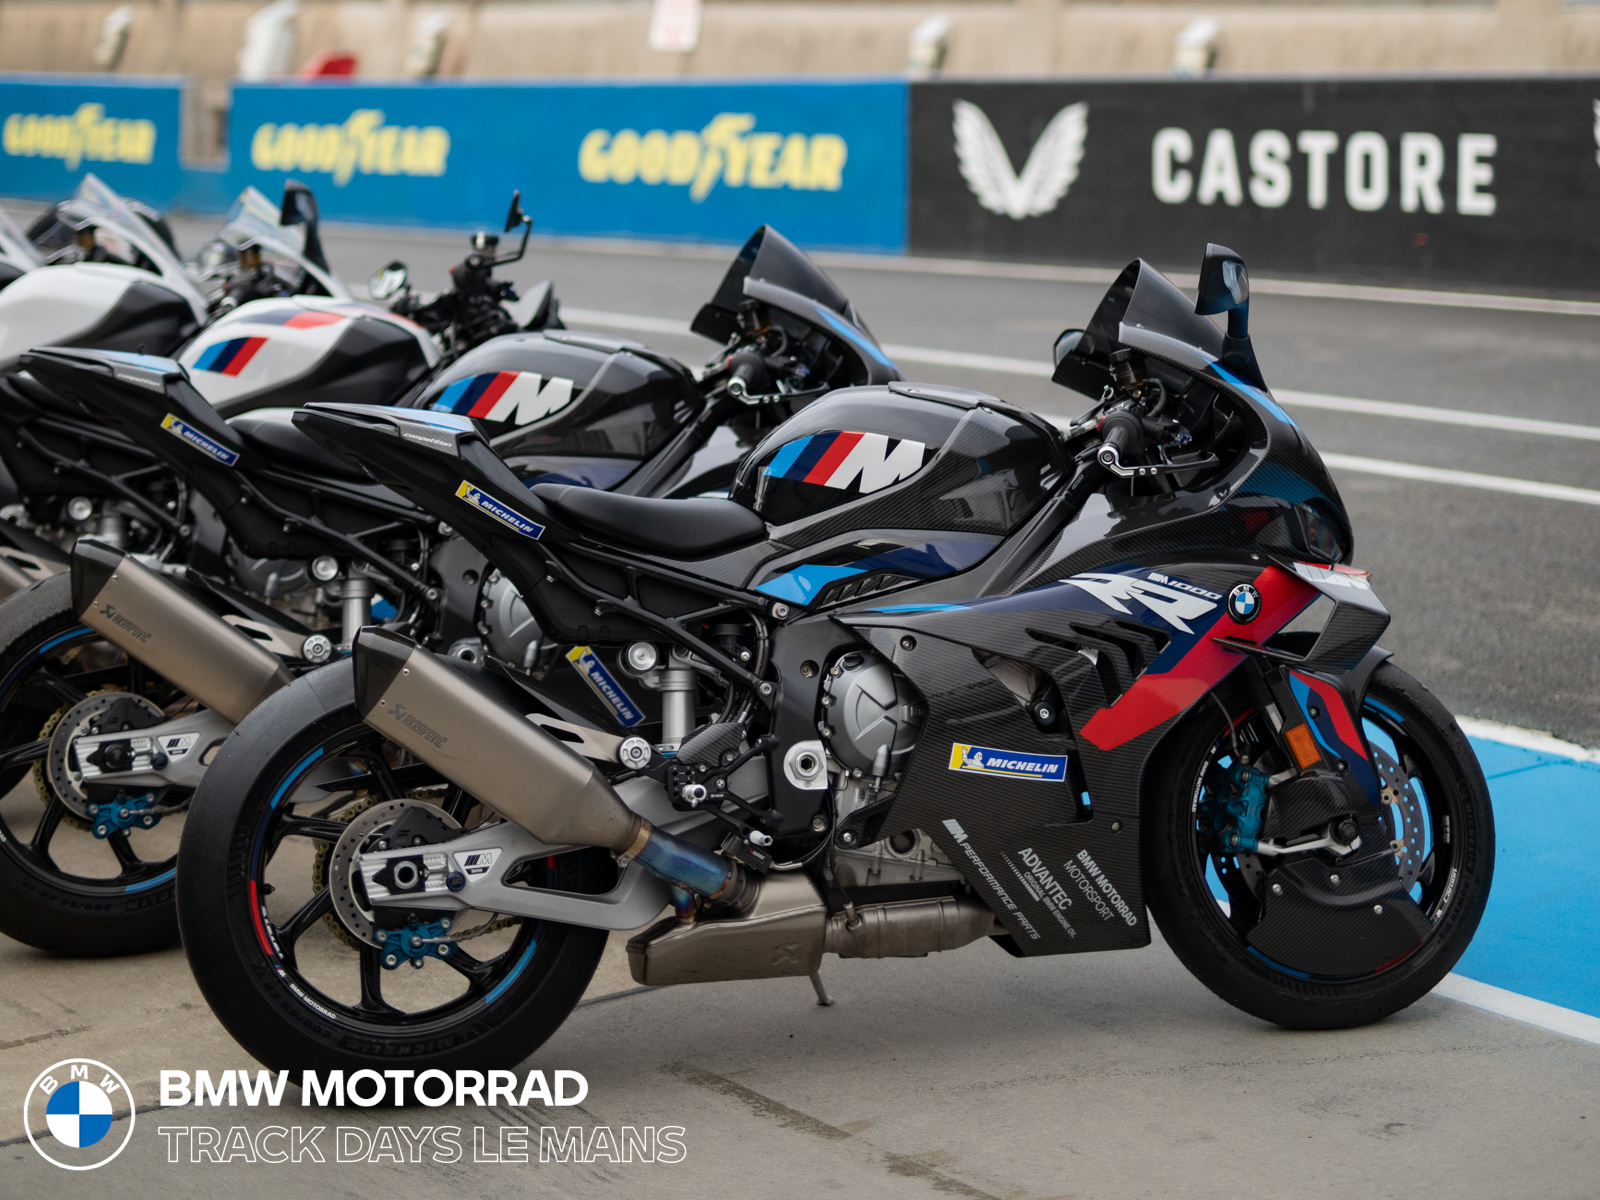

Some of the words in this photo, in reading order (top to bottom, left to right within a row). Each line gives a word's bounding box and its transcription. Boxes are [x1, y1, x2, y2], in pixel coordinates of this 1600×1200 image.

[251, 108, 450, 186] GOODYEAR
[578, 113, 848, 201] GOODYEAR
[1151, 127, 1498, 216] CASTORE
[183, 430, 231, 461] MICHELIN
[403, 431, 453, 448] competition
[823, 432, 926, 494] M
[480, 500, 534, 534] MICHELIN
[1233, 585, 1259, 598] BMW
[590, 671, 635, 720] MICHELIN
[986, 757, 1059, 774] MICHELIN
[960, 842, 1018, 911] PERFORMANCE
[1013, 912, 1041, 940] PARTS
[1018, 847, 1073, 910] ADVANTEC
[1023, 871, 1046, 899] ORIGINAL
[1043, 896, 1057, 911] BMW
[1053, 909, 1071, 931] ENGINE
[1067, 927, 1077, 938] OIL
[1063, 860, 1115, 921] MOTORSPORT
[1076, 849, 1102, 877] BMW
[1095, 874, 1138, 927] MOTORRAD
[290, 983, 304, 998] BMW
[303, 995, 337, 1019] MOTORRAD
